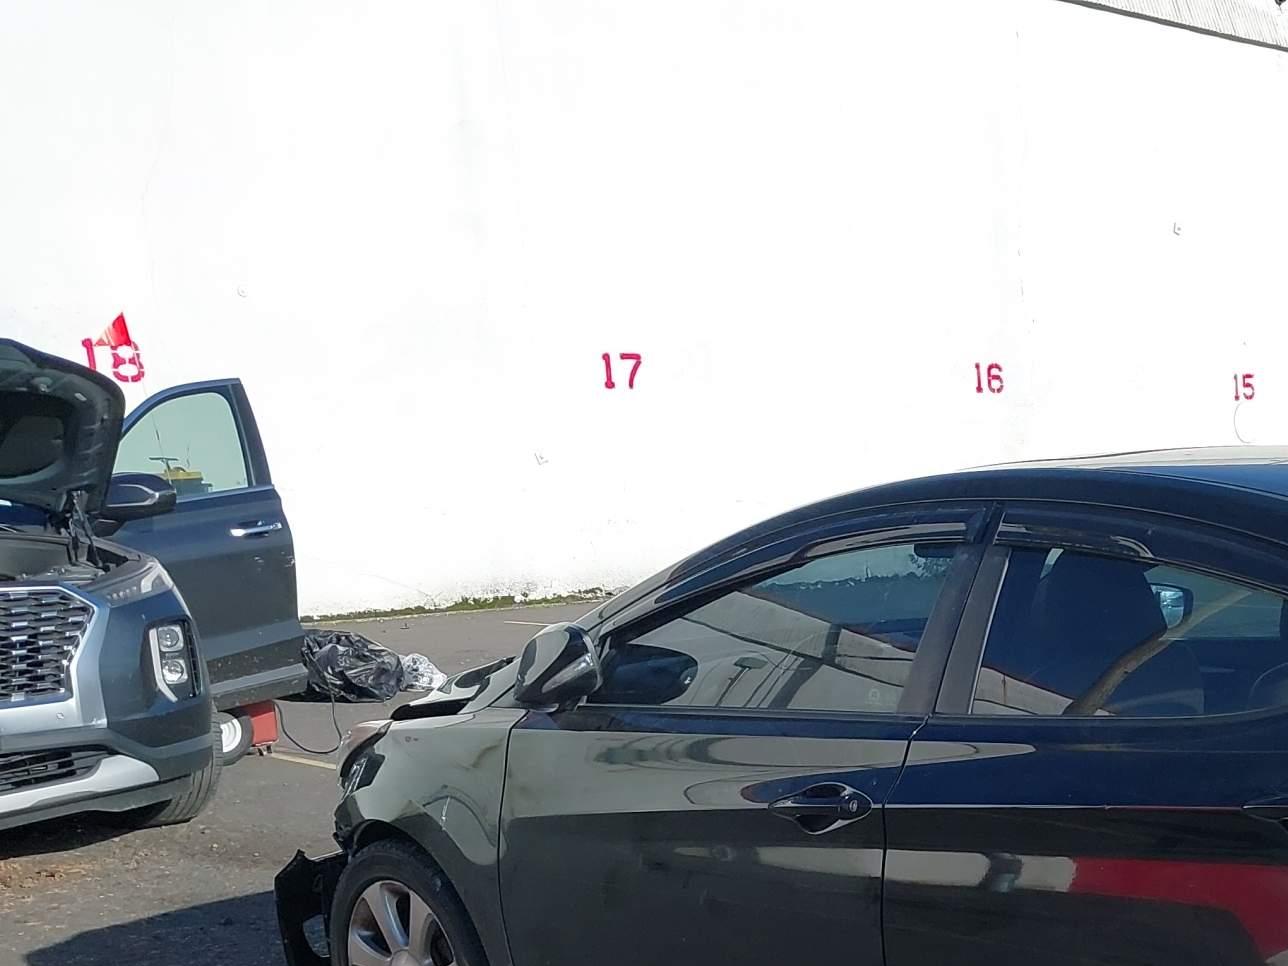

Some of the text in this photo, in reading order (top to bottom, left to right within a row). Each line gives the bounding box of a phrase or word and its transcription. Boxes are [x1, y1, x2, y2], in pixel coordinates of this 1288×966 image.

[82, 338, 145, 382] 18
[602, 352, 642, 389] 17
[975, 362, 1004, 393] 16
[1234, 373, 1255, 401] 15
